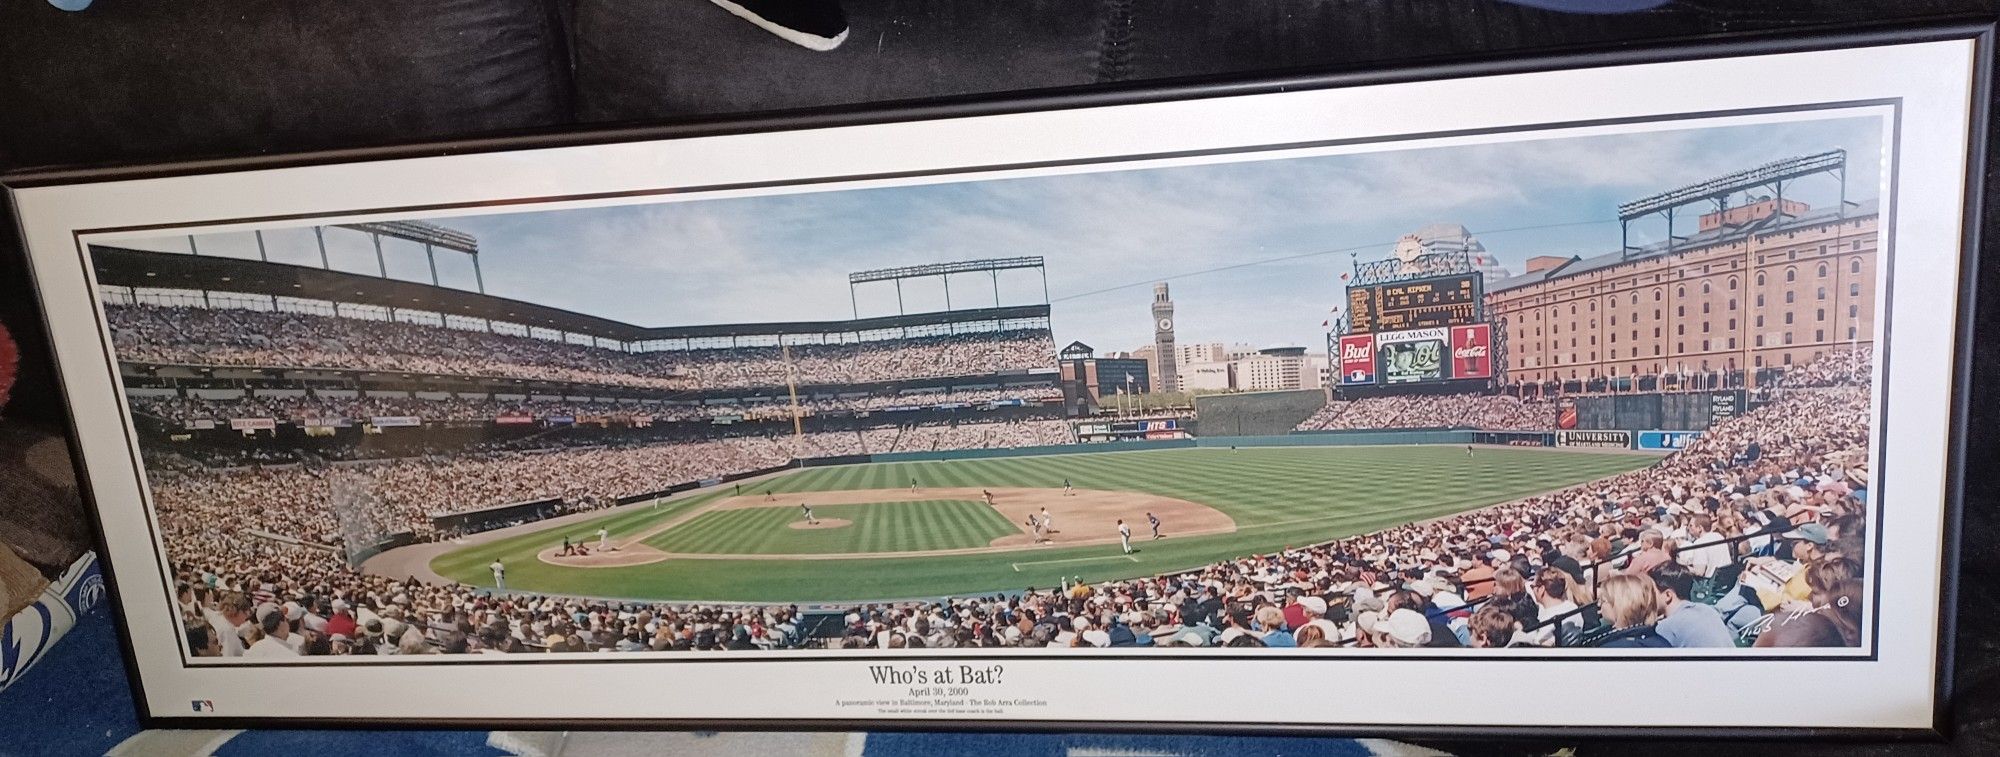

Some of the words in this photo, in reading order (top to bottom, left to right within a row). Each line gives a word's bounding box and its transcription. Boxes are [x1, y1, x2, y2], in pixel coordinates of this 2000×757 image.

[1379, 332, 1405, 342] LEGG
[1407, 328, 1444, 340] MASON
[1343, 342, 1372, 360] Bud
[1147, 420, 1166, 431] HTS
[1568, 432, 1625, 442] UNIVERSITY
[869, 665, 928, 684] Who's
[934, 667, 954, 684] at
[960, 665, 1004, 684] Bat?
[908, 688, 930, 697] April
[932, 688, 946, 697] 30,
[948, 688, 969, 696] 2000
[934, 699, 964, 707] Maryland
